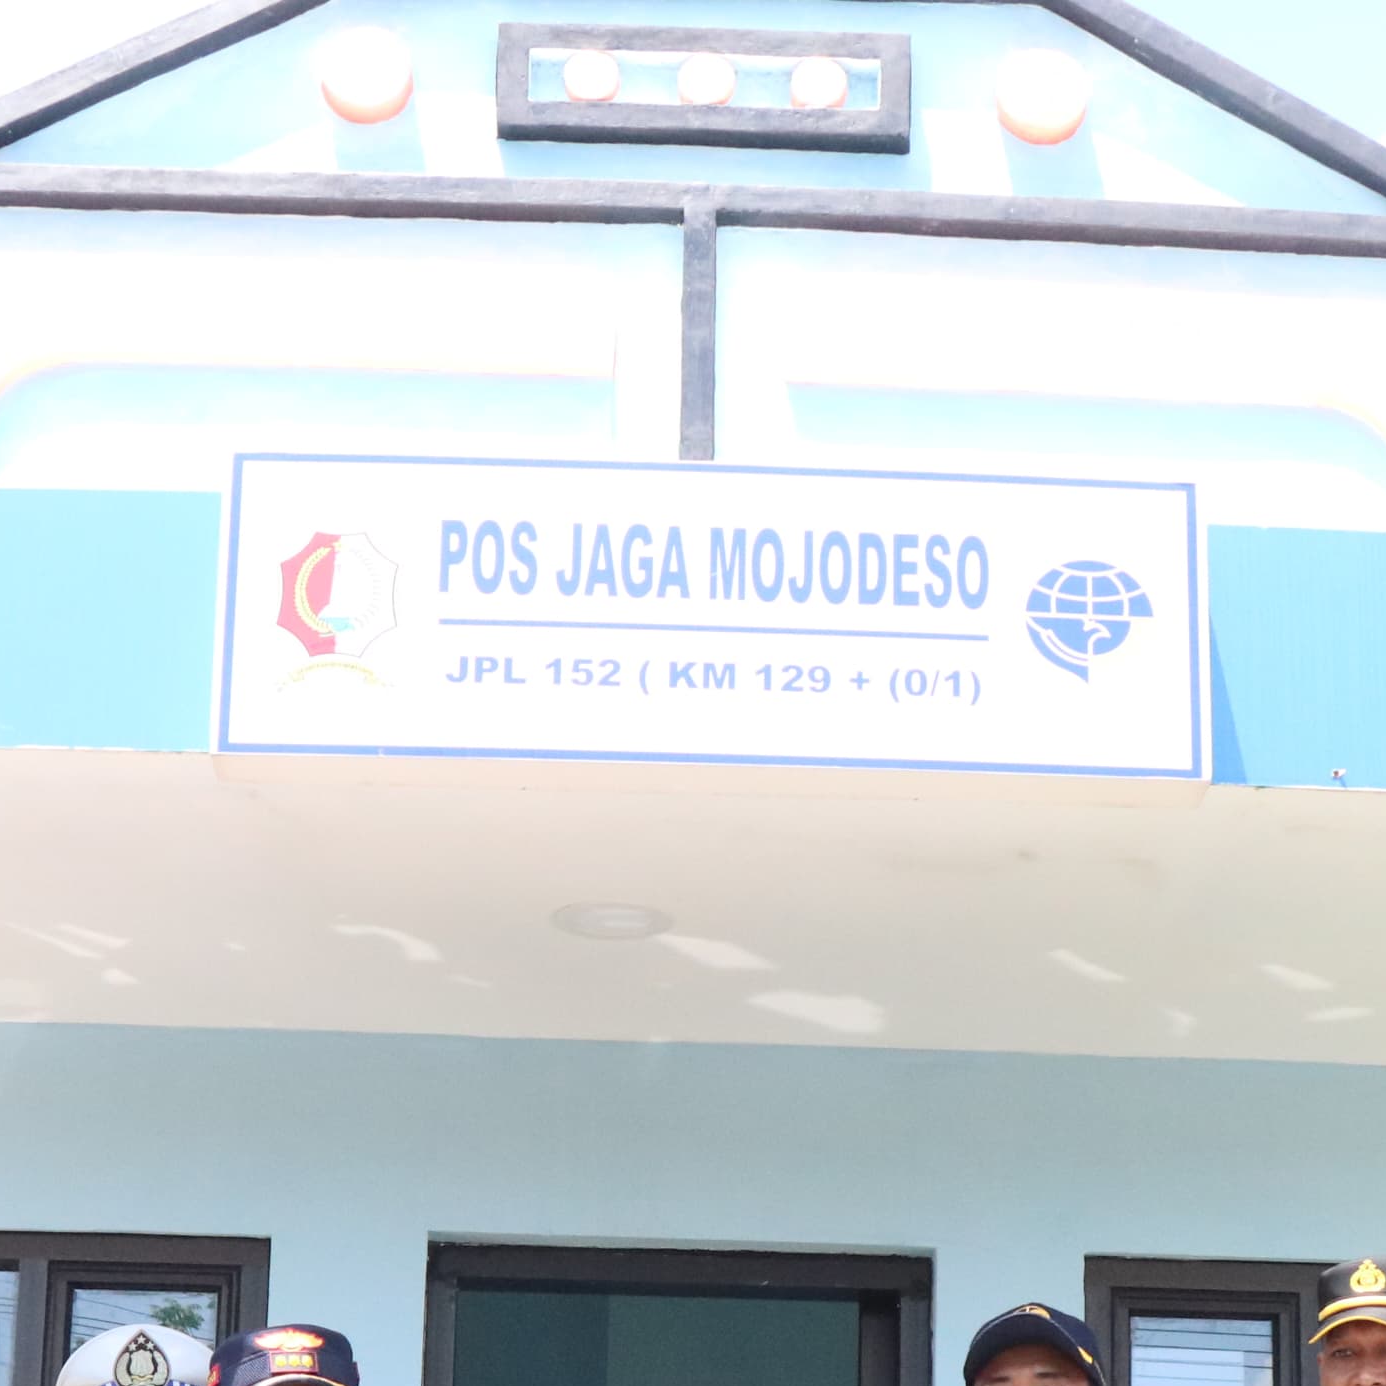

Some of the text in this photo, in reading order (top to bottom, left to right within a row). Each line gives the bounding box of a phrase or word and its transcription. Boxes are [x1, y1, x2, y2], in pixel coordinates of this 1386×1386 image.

[438, 519, 989, 610] POS JAGA MOJODESO
[445, 655, 526, 684] JPL
[545, 657, 621, 687] 152
[668, 661, 736, 690] KM
[755, 664, 832, 693] 129
[849, 670, 870, 691] +
[888, 668, 981, 706] (0/1)
